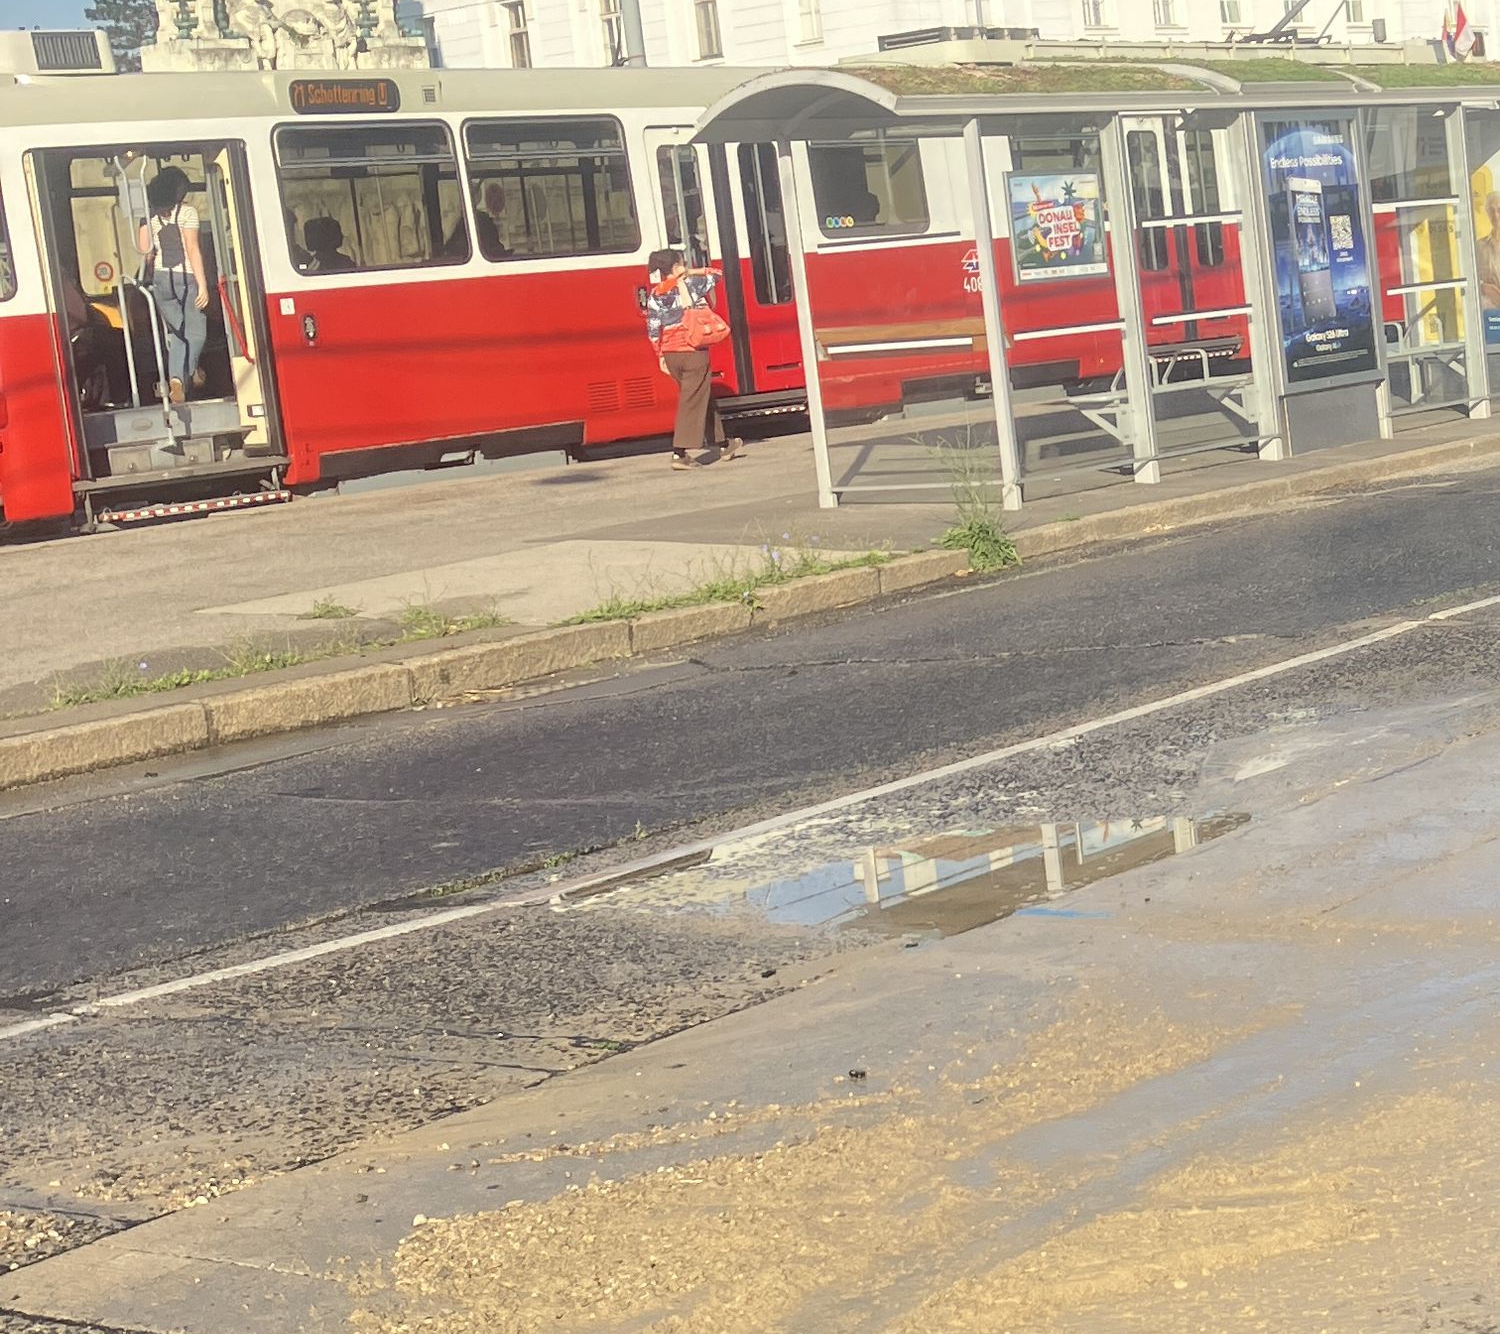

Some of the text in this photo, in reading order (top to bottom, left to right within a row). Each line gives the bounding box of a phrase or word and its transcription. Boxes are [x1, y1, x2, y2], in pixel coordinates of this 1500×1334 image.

[294, 82, 305, 107] 71
[307, 83, 376, 106] Schottenring
[1269, 152, 1343, 169] Endless Possibilities
[1039, 210, 1073, 225] DONAU
[1053, 221, 1080, 235] INSEL
[1048, 235, 1071, 248] FEST
[1306, 332, 1327, 343] Galaxy
